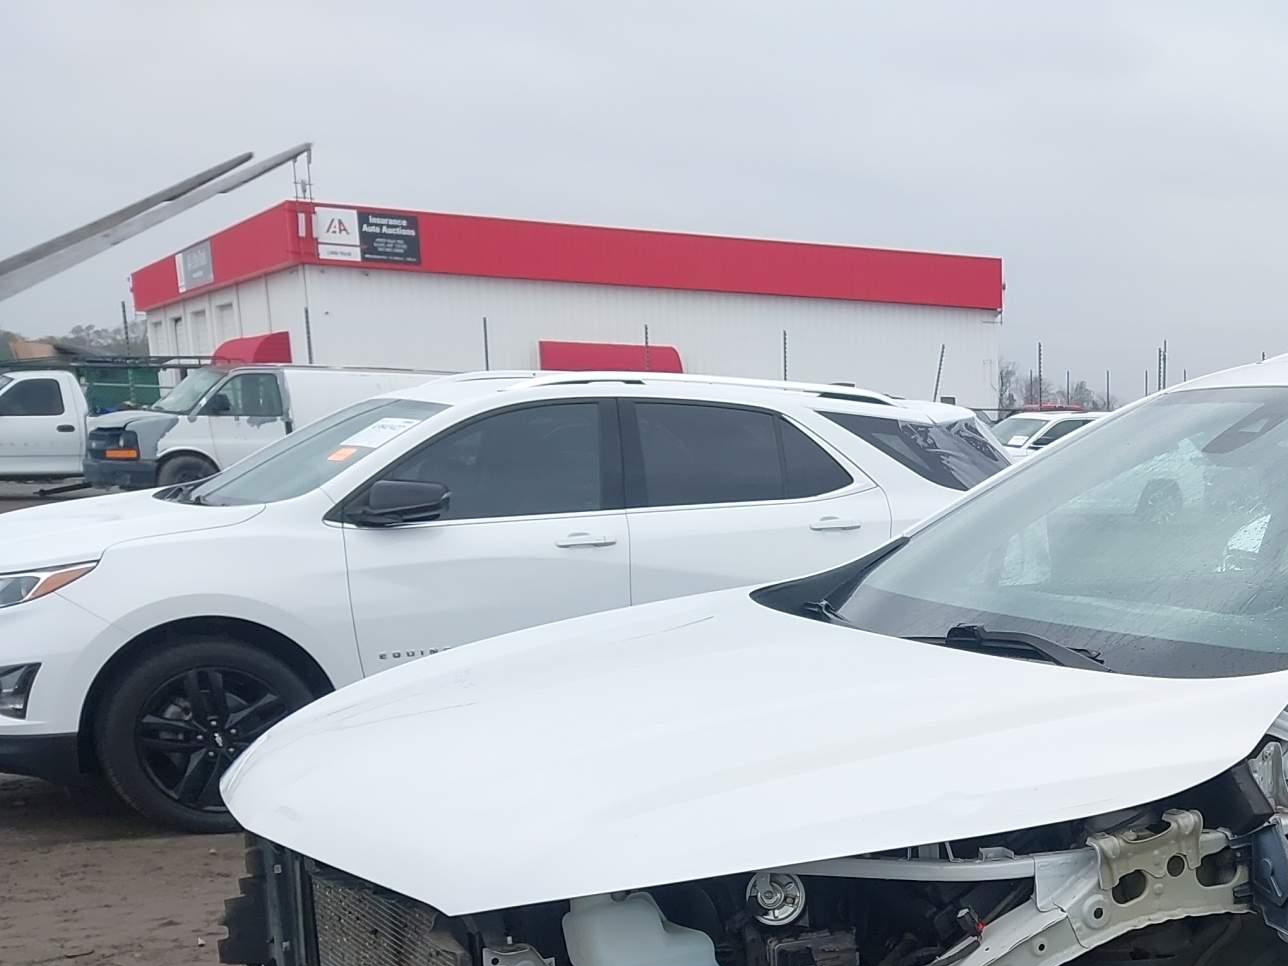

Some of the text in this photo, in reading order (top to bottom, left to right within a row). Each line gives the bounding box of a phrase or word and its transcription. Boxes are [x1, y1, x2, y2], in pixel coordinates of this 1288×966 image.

[369, 215, 407, 226] Insurance
[361, 223, 416, 236] Auto Auctions
